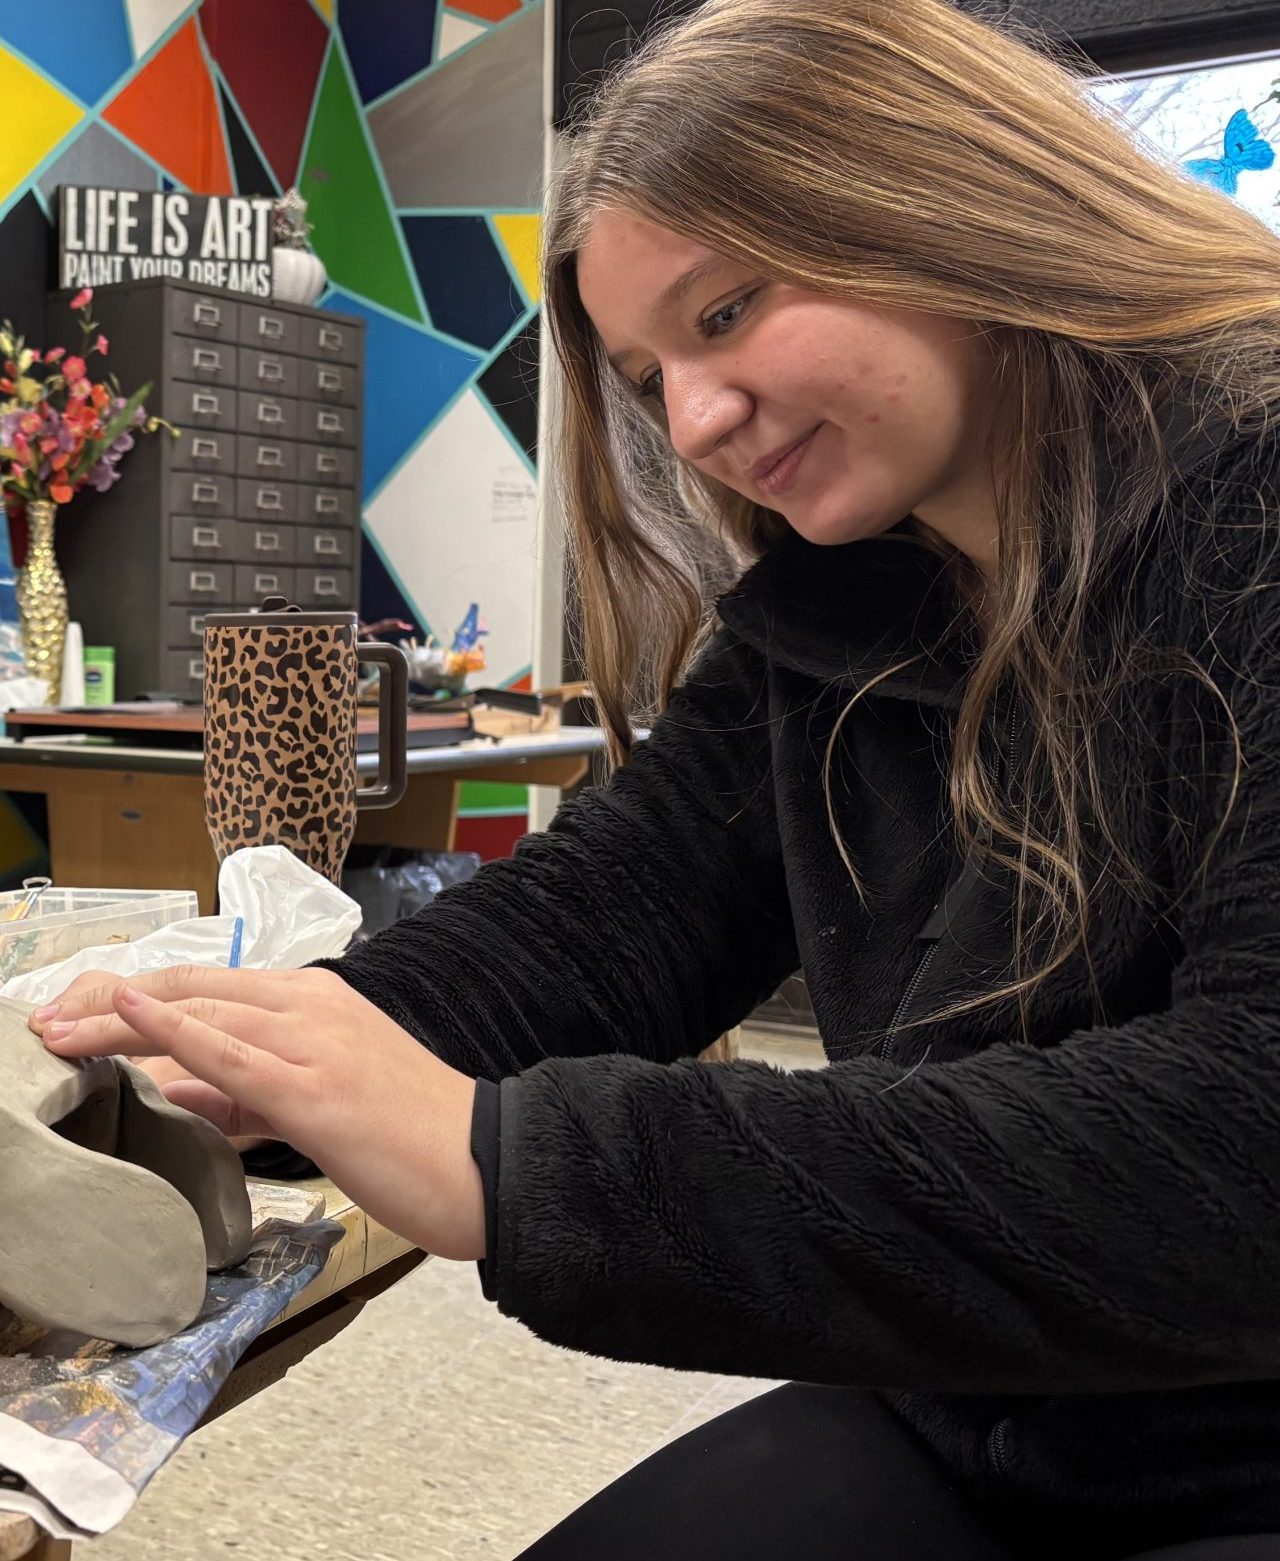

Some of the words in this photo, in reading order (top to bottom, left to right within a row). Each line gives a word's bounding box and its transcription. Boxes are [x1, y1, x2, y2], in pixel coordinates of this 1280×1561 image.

[65, 187, 139, 254] LIFE
[151, 193, 189, 257] IS
[200, 197, 272, 261] ART
[64, 252, 124, 289] PAINT
[130, 257, 184, 280] YOUR
[189, 259, 271, 298] DREAMS
